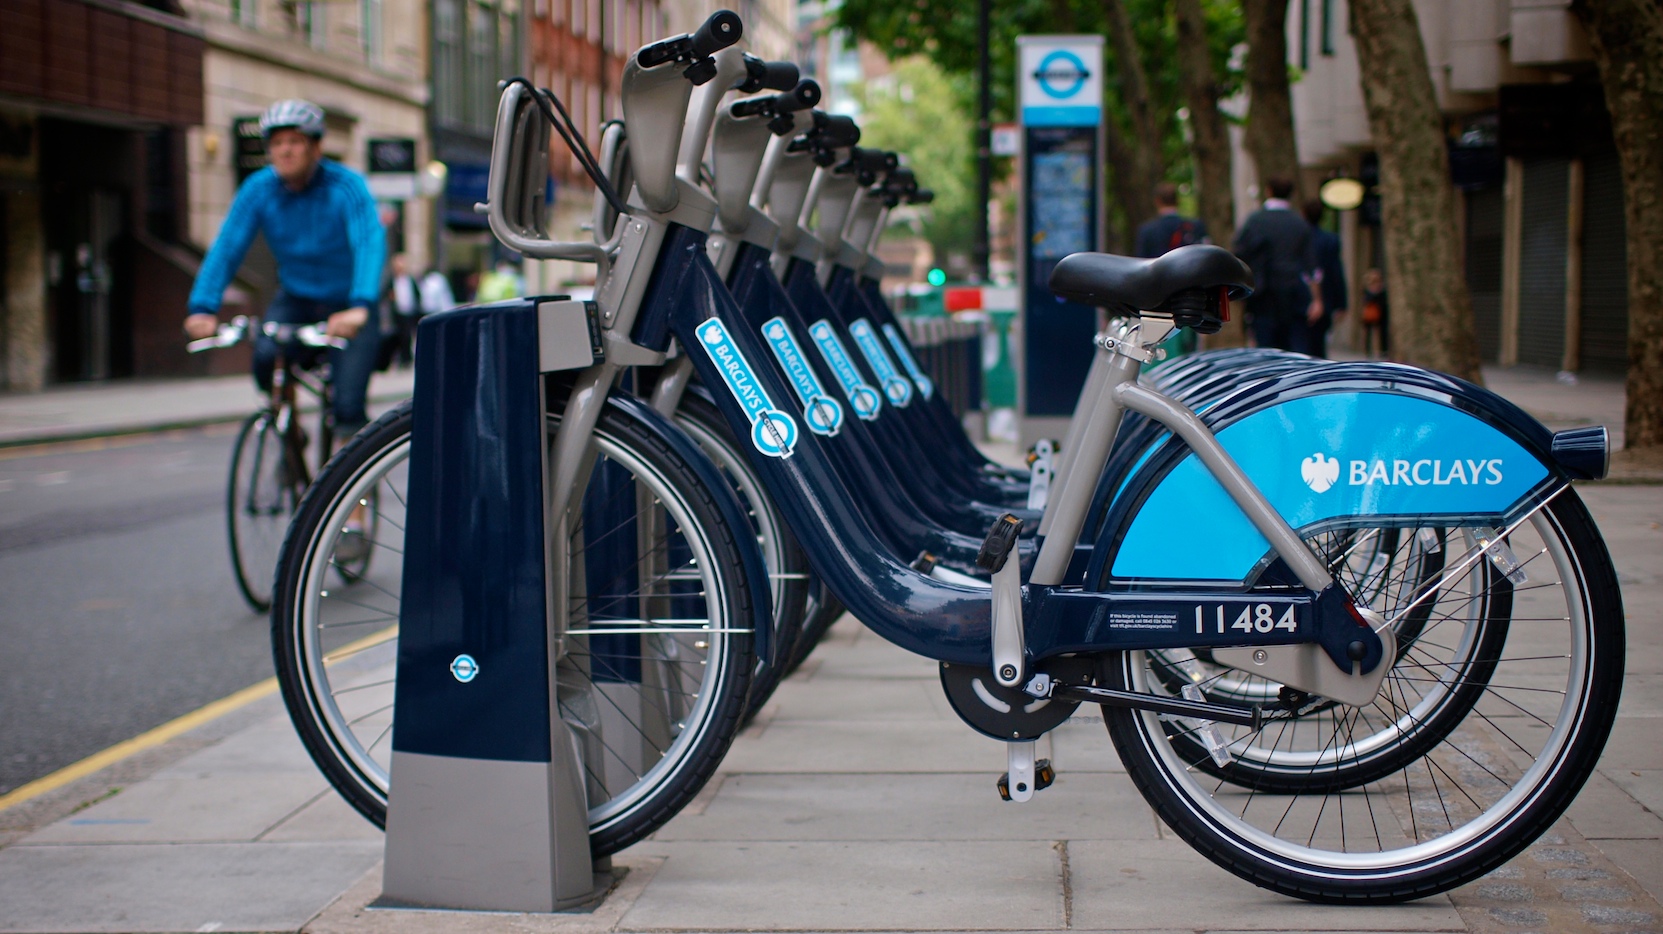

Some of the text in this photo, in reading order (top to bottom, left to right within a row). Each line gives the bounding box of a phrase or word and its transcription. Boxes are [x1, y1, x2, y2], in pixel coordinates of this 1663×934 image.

[714, 345, 763, 409] BARCLAYS
[777, 340, 815, 395] BARCLAYS
[764, 418, 777, 436] CYCLE
[1349, 459, 1503, 486] BARCLAYS
[1195, 603, 1297, 634] 11484
